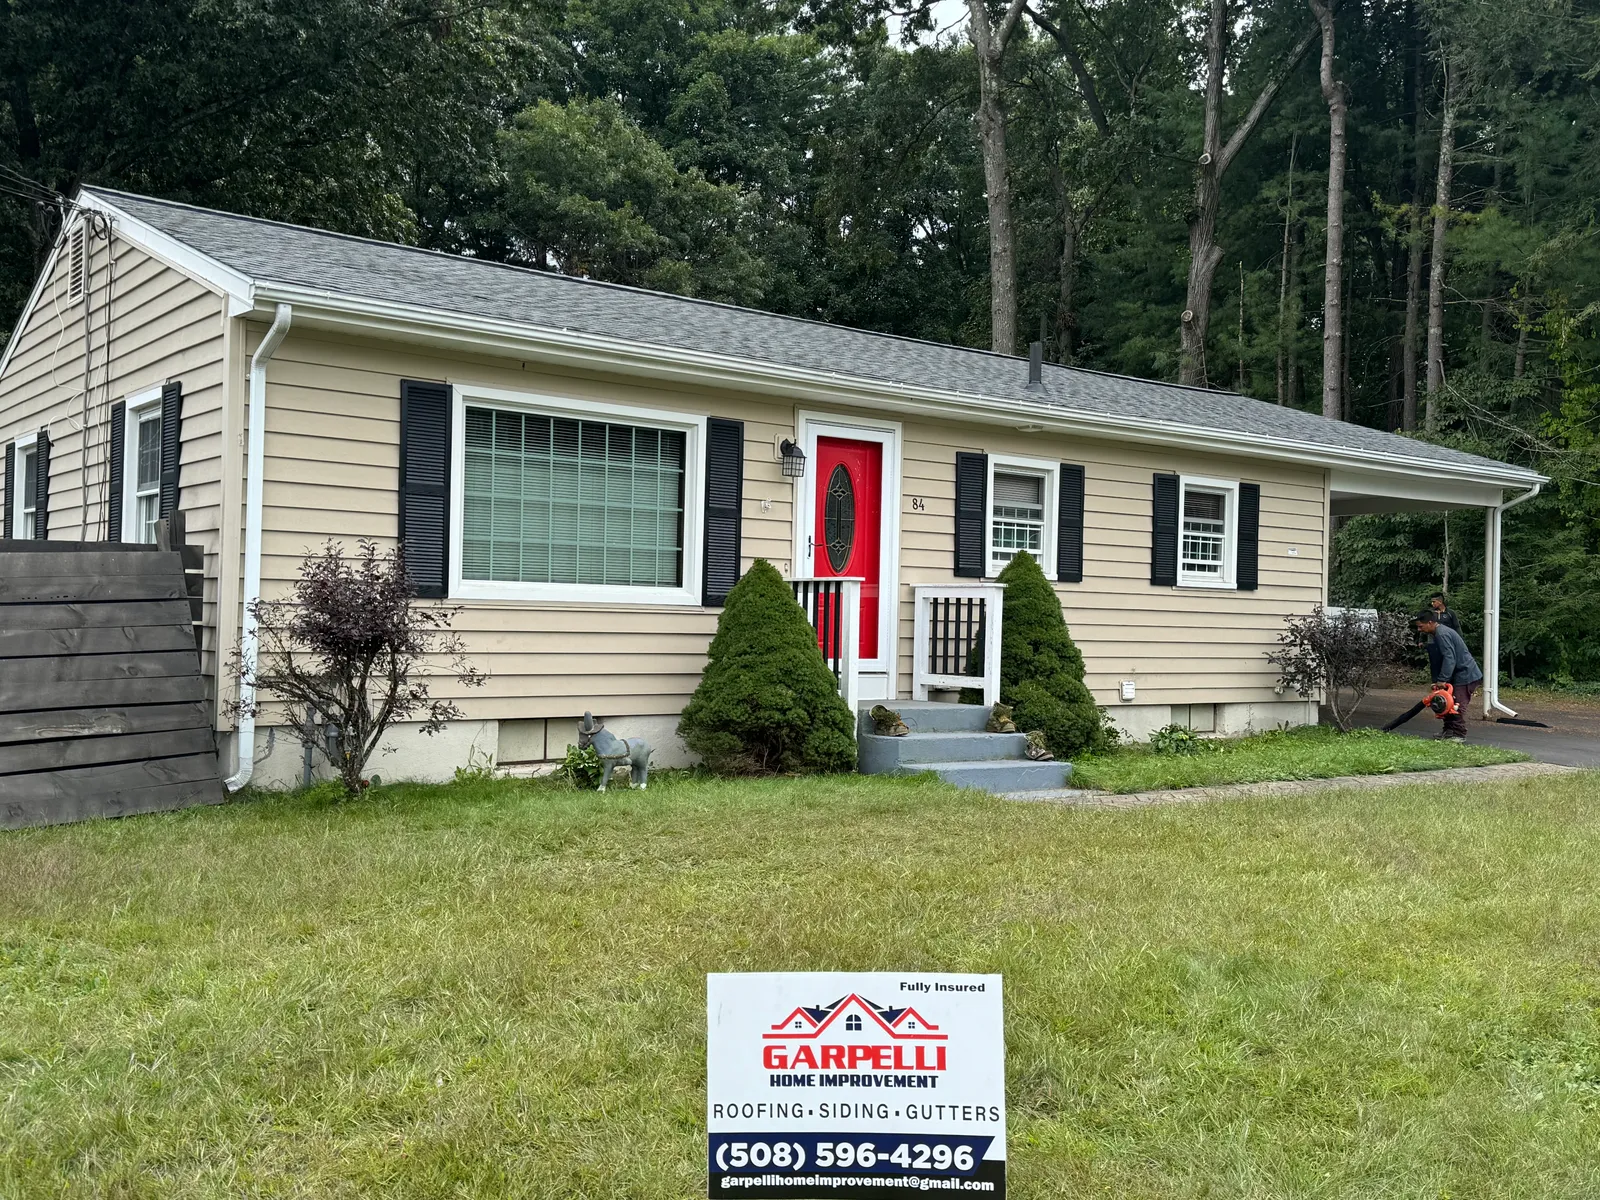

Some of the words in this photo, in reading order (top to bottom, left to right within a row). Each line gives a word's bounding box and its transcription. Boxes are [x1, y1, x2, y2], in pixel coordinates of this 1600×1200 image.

[912, 498, 925, 511] 84
[899, 981, 931, 993] Fully
[934, 982, 986, 993] Insured
[762, 1045, 947, 1071] GARPELLI
[769, 1074, 816, 1087] HOME
[819, 1074, 939, 1088] IMPROVEMENT
[713, 1103, 804, 1119] ROOFING
[818, 1103, 889, 1120] SIDING
[905, 1104, 1000, 1122] GUTTERS
[715, 1142, 806, 1172] (508)
[814, 1142, 974, 1171] 596-4296
[720, 1174, 995, 1192] garpellihomeimprovement@gmail.com
